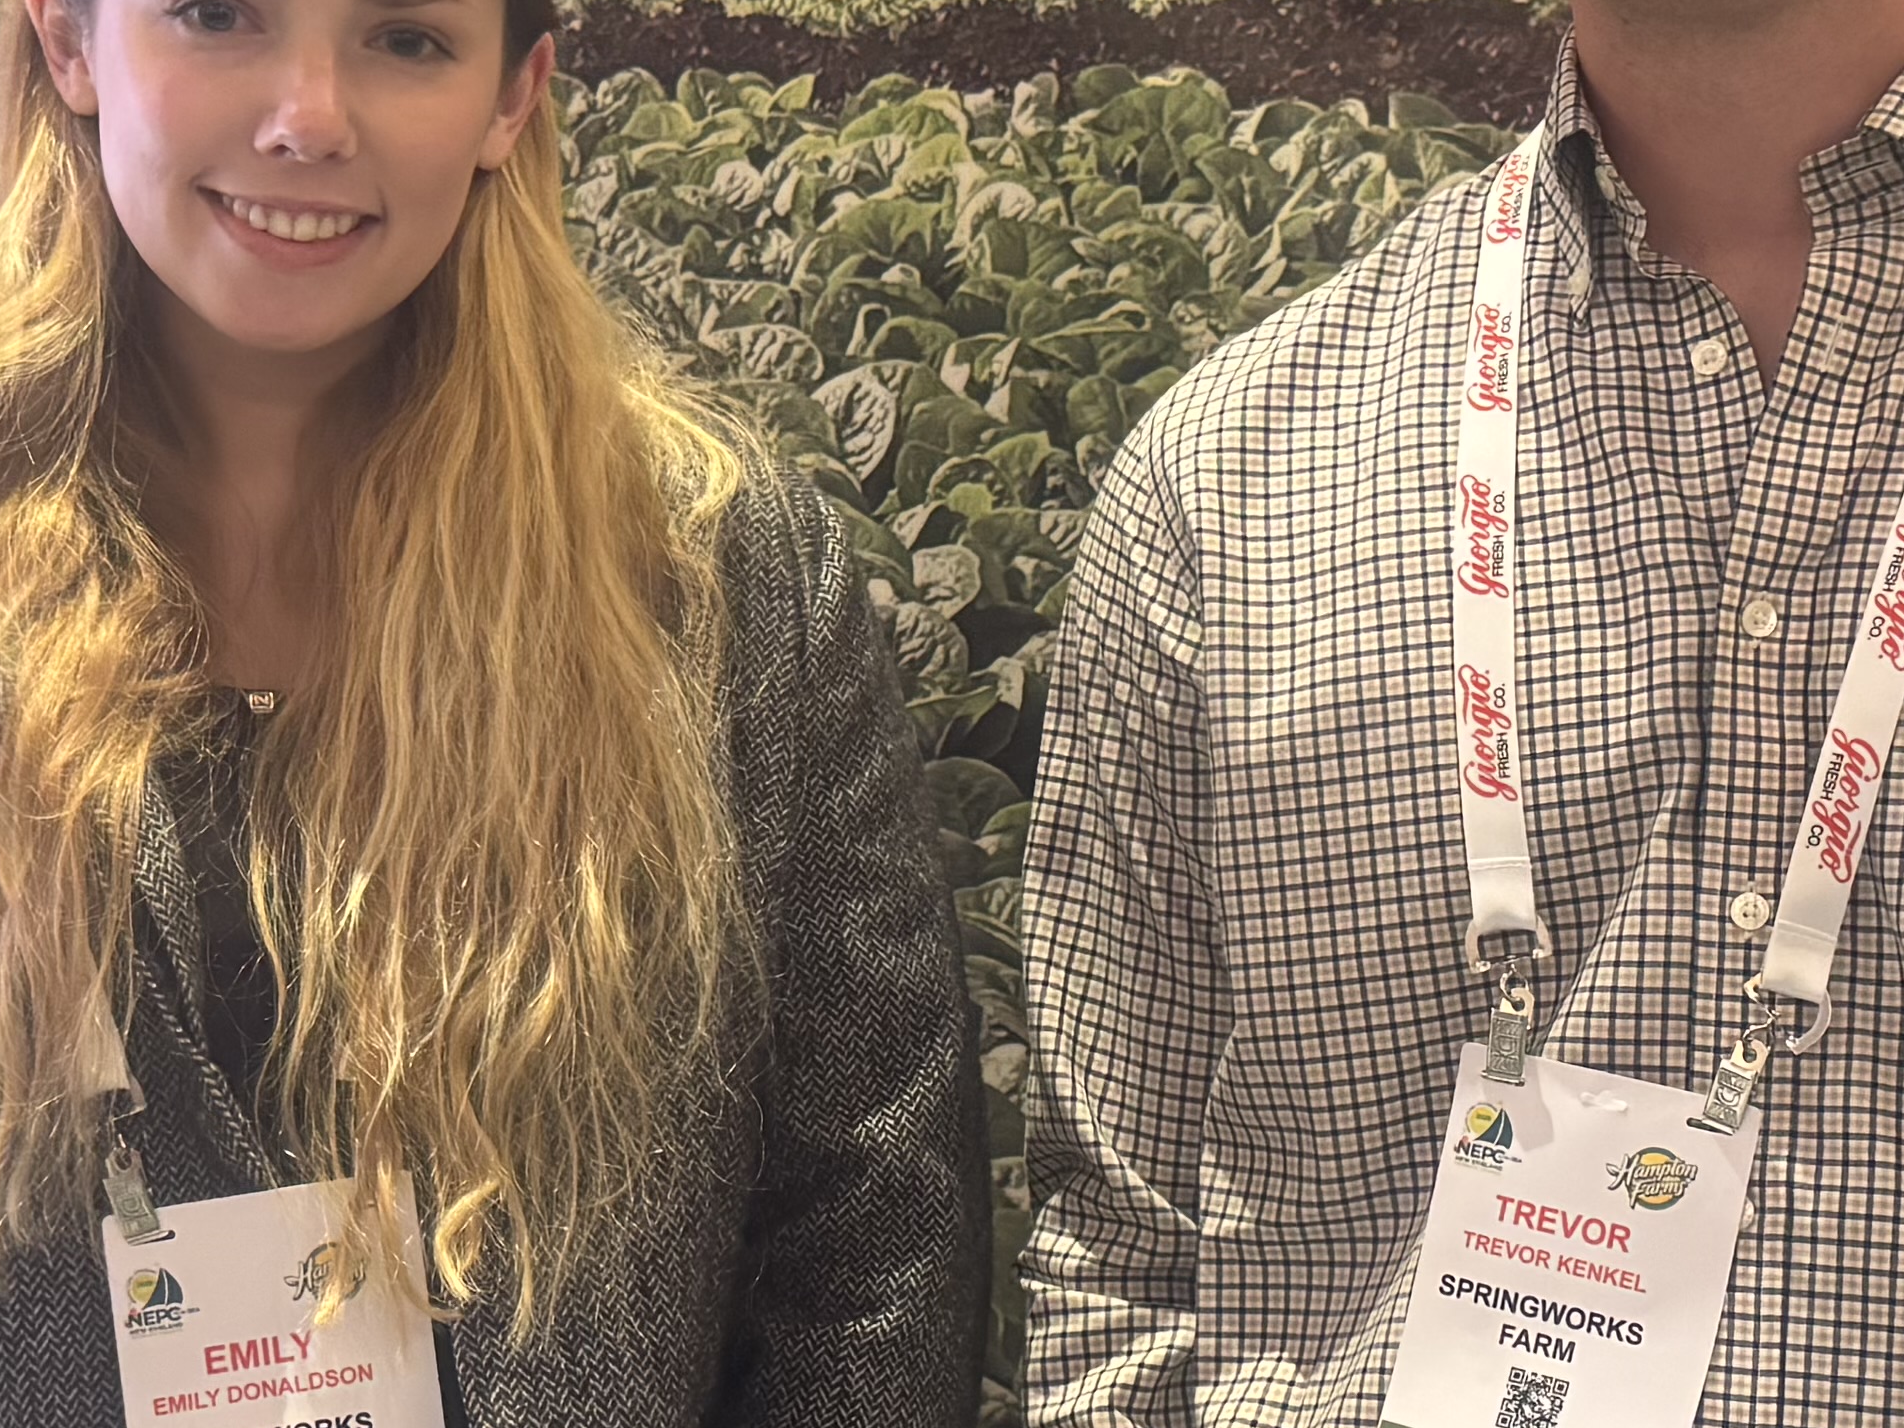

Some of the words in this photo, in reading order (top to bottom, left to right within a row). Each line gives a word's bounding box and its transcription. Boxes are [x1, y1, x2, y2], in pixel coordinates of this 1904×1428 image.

[1501, 311, 1511, 333] CO.
[1466, 303, 1514, 412] Giorgio
[1497, 352, 1509, 393] FRESH
[1493, 490, 1505, 513] CO.
[1457, 474, 1509, 599] Giorgio
[1492, 535, 1505, 577] FRESH
[1867, 615, 1886, 641] CO.
[1493, 683, 1506, 708] CO.
[1458, 664, 1518, 801] Giorgio
[1496, 732, 1509, 779] FRESH
[1818, 752, 1844, 801] FRESH
[1811, 728, 1880, 884] Giorgio
[1805, 824, 1825, 849] CO.
[1607, 1153, 1698, 1190] Hampton
[1629, 1180, 1687, 1209] Farms
[1495, 1195, 1631, 1253] TREVOR
[1463, 1230, 1550, 1271] TREVOR
[1556, 1256, 1646, 1294] KENKEL
[1439, 1274, 1643, 1346] SPRINGWORKS
[203, 1332, 313, 1375] EMILY
[1498, 1324, 1576, 1363] FARM
[153, 1389, 220, 1417] EMILY
[226, 1363, 373, 1406] DONALDSON
